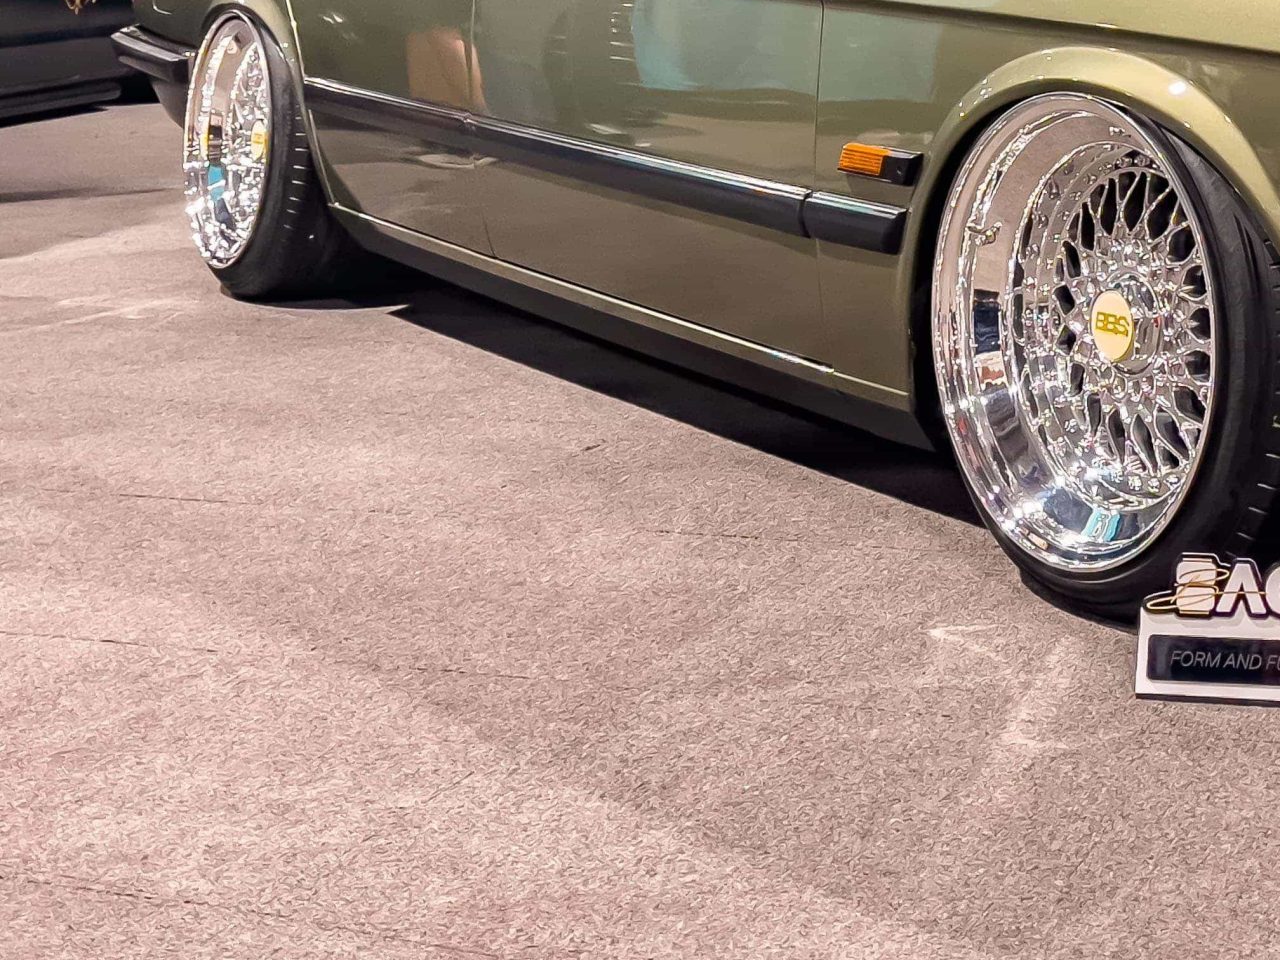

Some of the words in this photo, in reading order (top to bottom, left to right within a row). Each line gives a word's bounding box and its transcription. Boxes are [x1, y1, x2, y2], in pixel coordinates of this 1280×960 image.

[1096, 311, 1130, 337] BBS
[1171, 650, 1220, 669] FORM
[1223, 653, 1262, 671] AND
